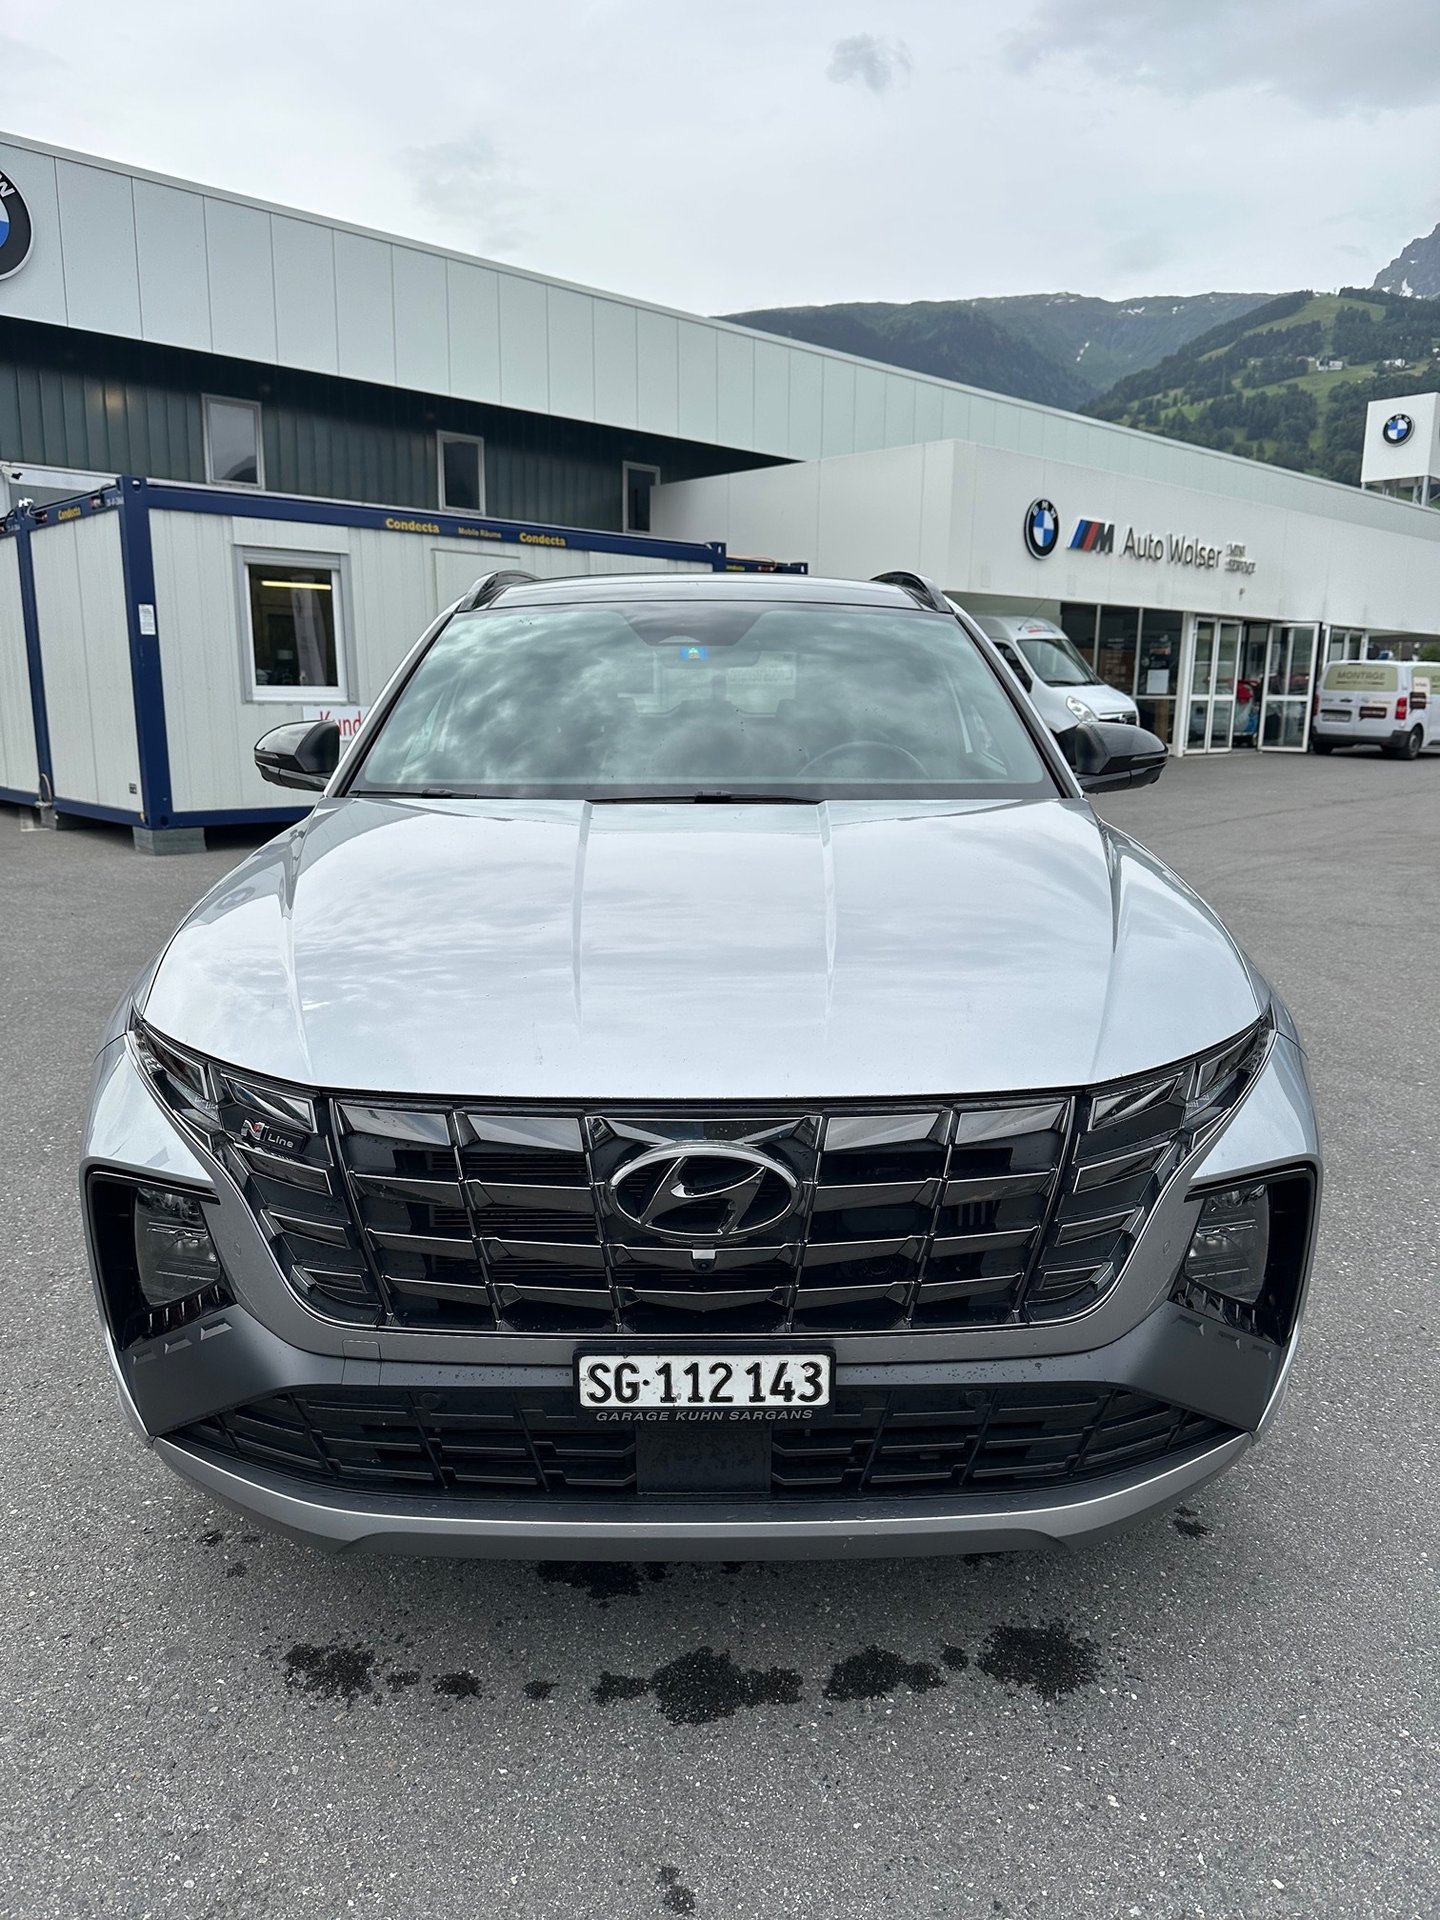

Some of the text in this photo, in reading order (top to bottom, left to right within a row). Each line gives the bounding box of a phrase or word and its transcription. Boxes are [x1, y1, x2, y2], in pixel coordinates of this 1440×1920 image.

[385, 518, 440, 534] Condecta
[519, 532, 566, 547] Condecta
[1122, 527, 1222, 569] Auto Walser
[267, 1133, 294, 1149] Line
[595, 1409, 814, 1421] GARAGE KUHN SARGANS
